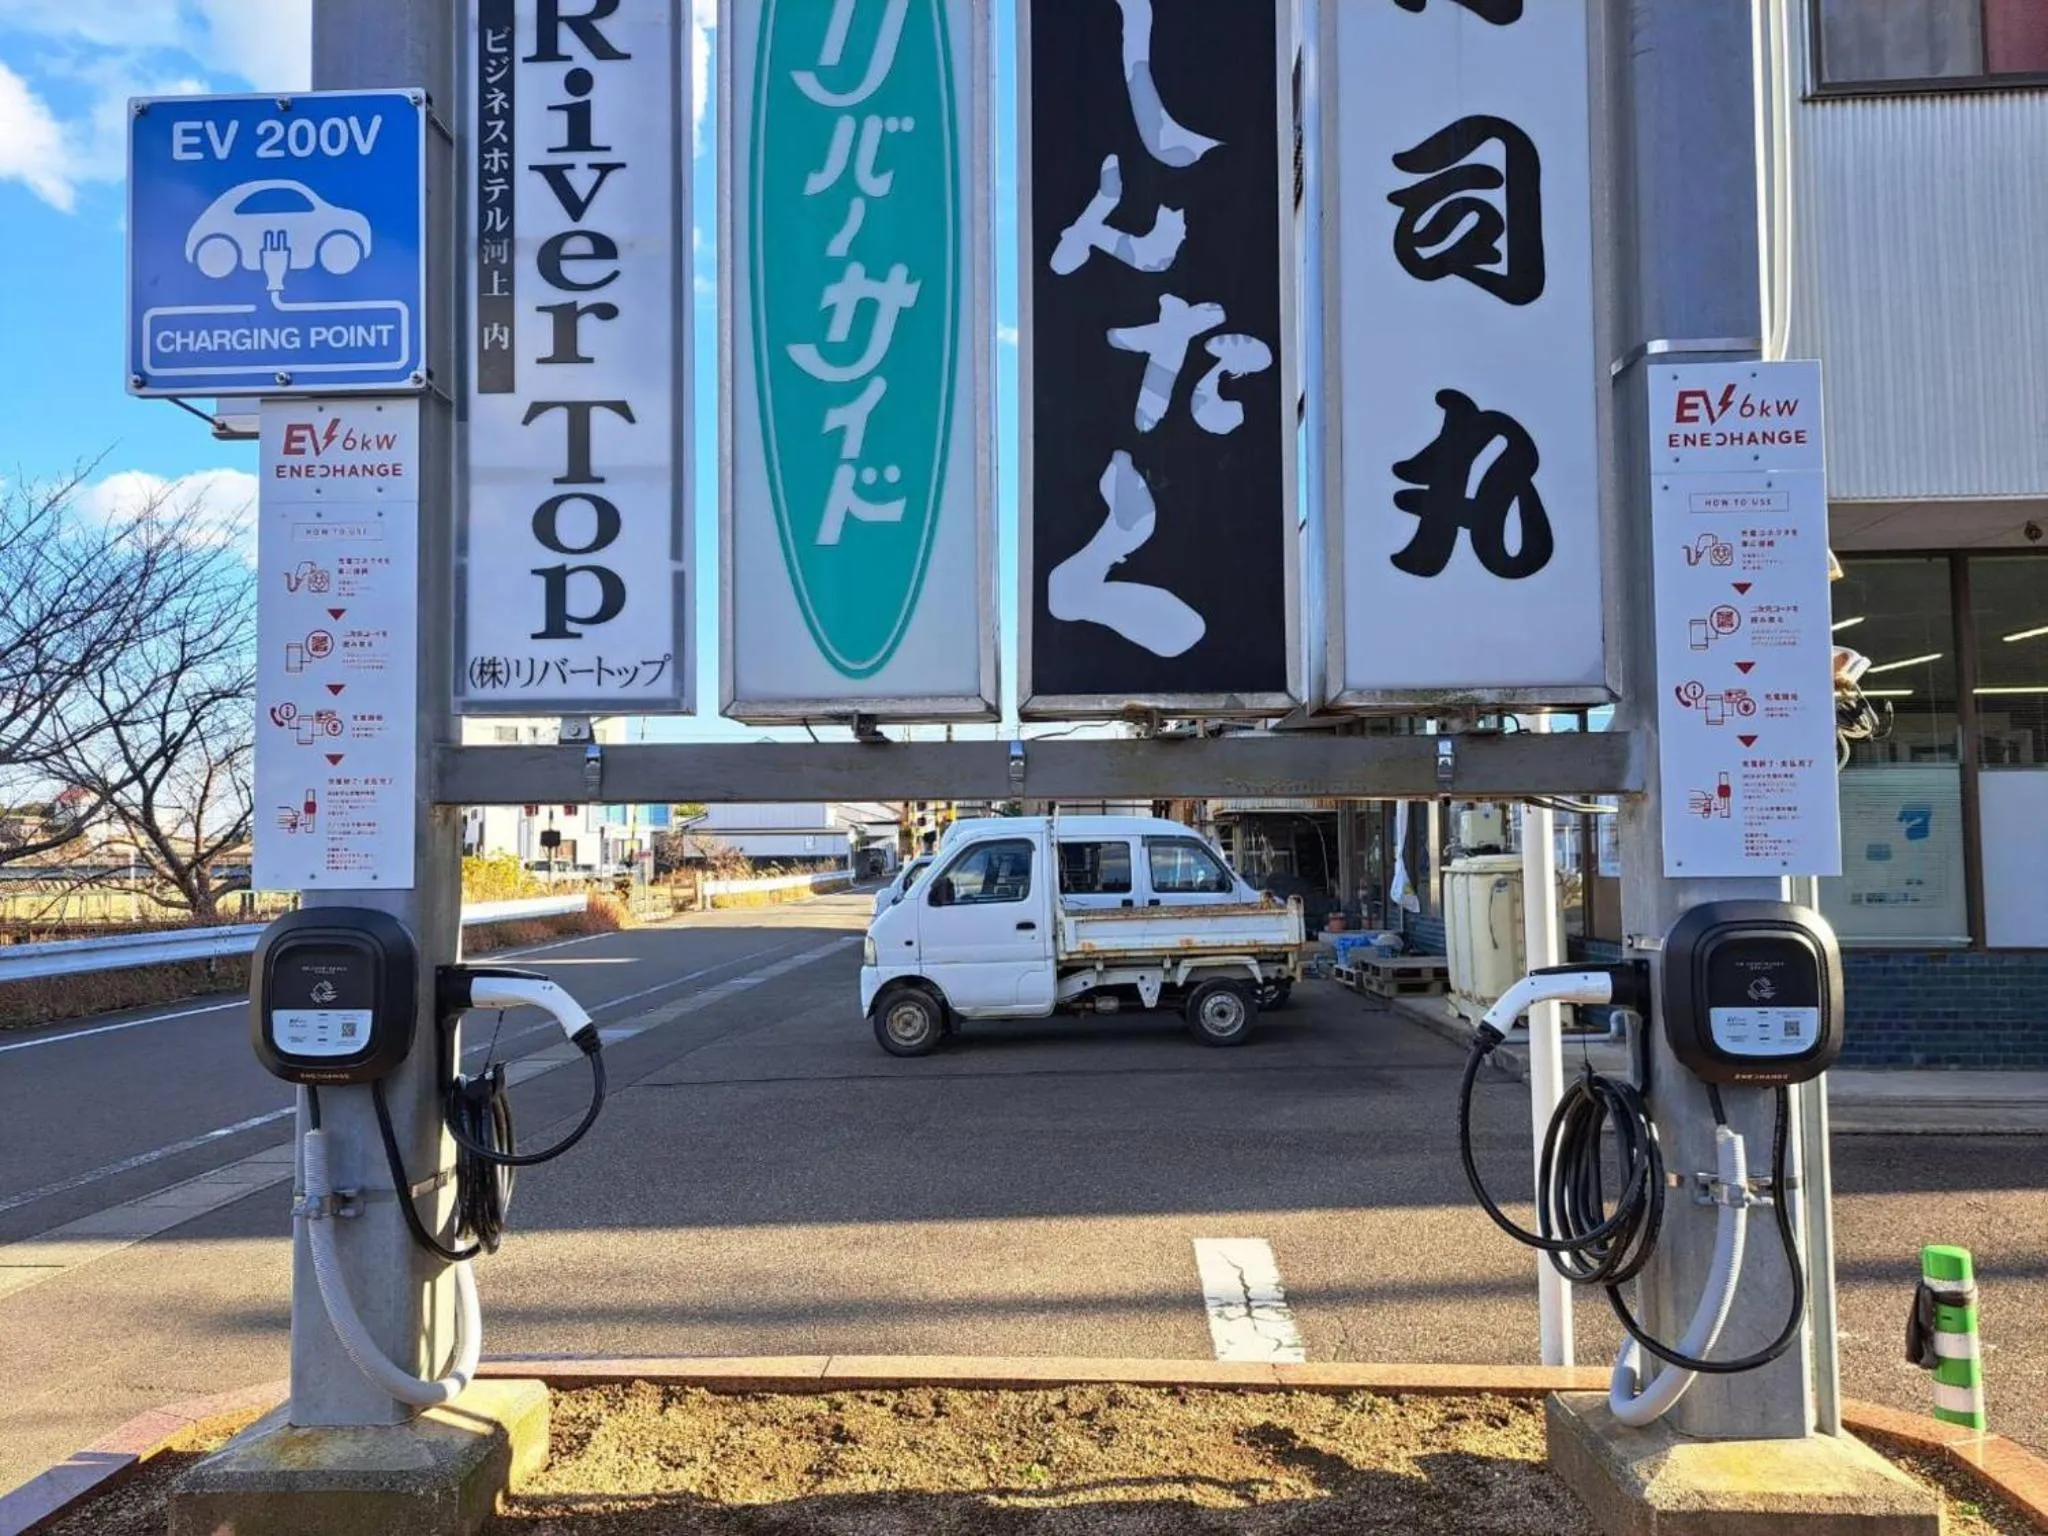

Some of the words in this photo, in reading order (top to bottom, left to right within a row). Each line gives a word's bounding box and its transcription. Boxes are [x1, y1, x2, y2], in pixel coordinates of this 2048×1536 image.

[172, 118, 240, 161] EV
[256, 114, 383, 159] 200V
[522, 0, 632, 364] River
[156, 326, 301, 354] CHARGING
[310, 324, 395, 349] POINT
[785, 0, 922, 547] リバーサイド
[1048, 0, 1273, 657] しんたく
[1387, 0, 1554, 580] 司丸
[283, 418, 341, 457] EV
[342, 428, 398, 451] 6kW
[522, 400, 636, 640] Top
[1675, 383, 1737, 426] EV
[1738, 393, 1799, 419] 6kW
